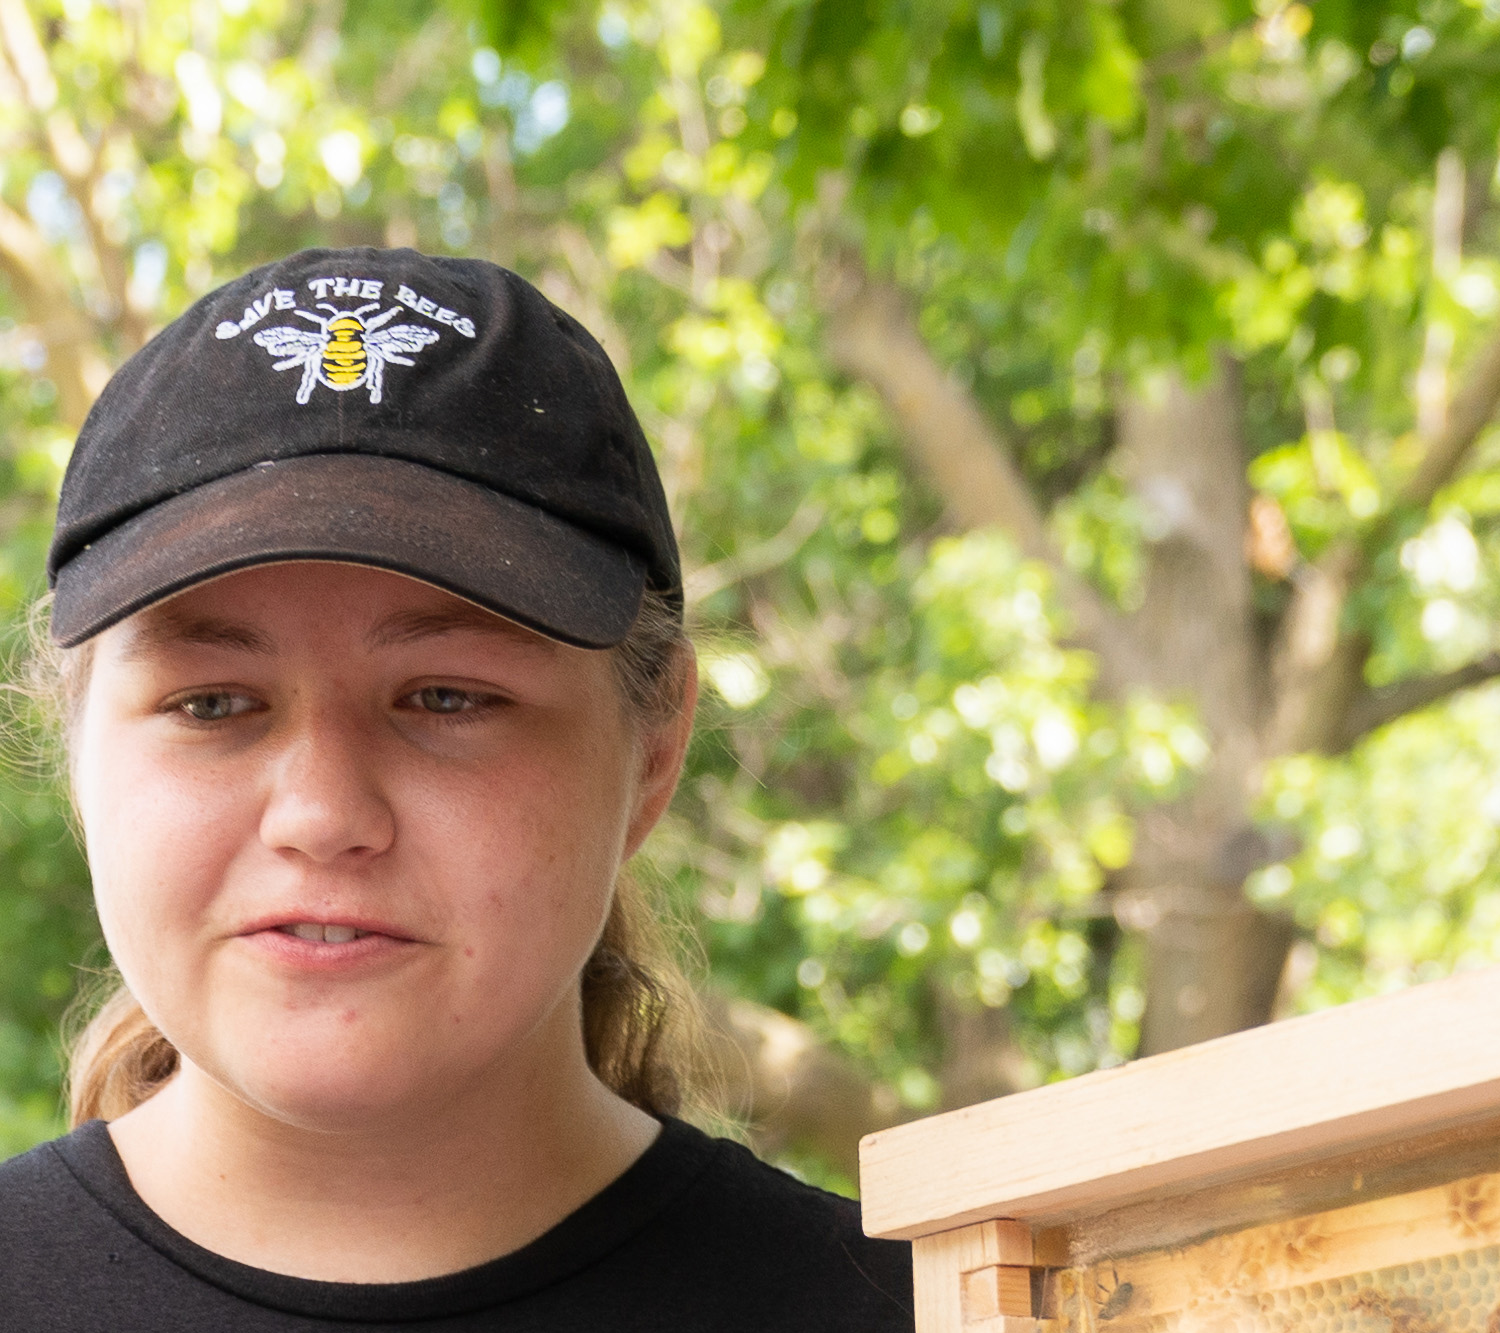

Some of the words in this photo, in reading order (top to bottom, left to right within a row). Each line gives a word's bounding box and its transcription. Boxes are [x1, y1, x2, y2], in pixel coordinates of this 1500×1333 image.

[215, 287, 297, 340] SAVE
[308, 276, 384, 300] THE
[394, 284, 476, 339] BEES
